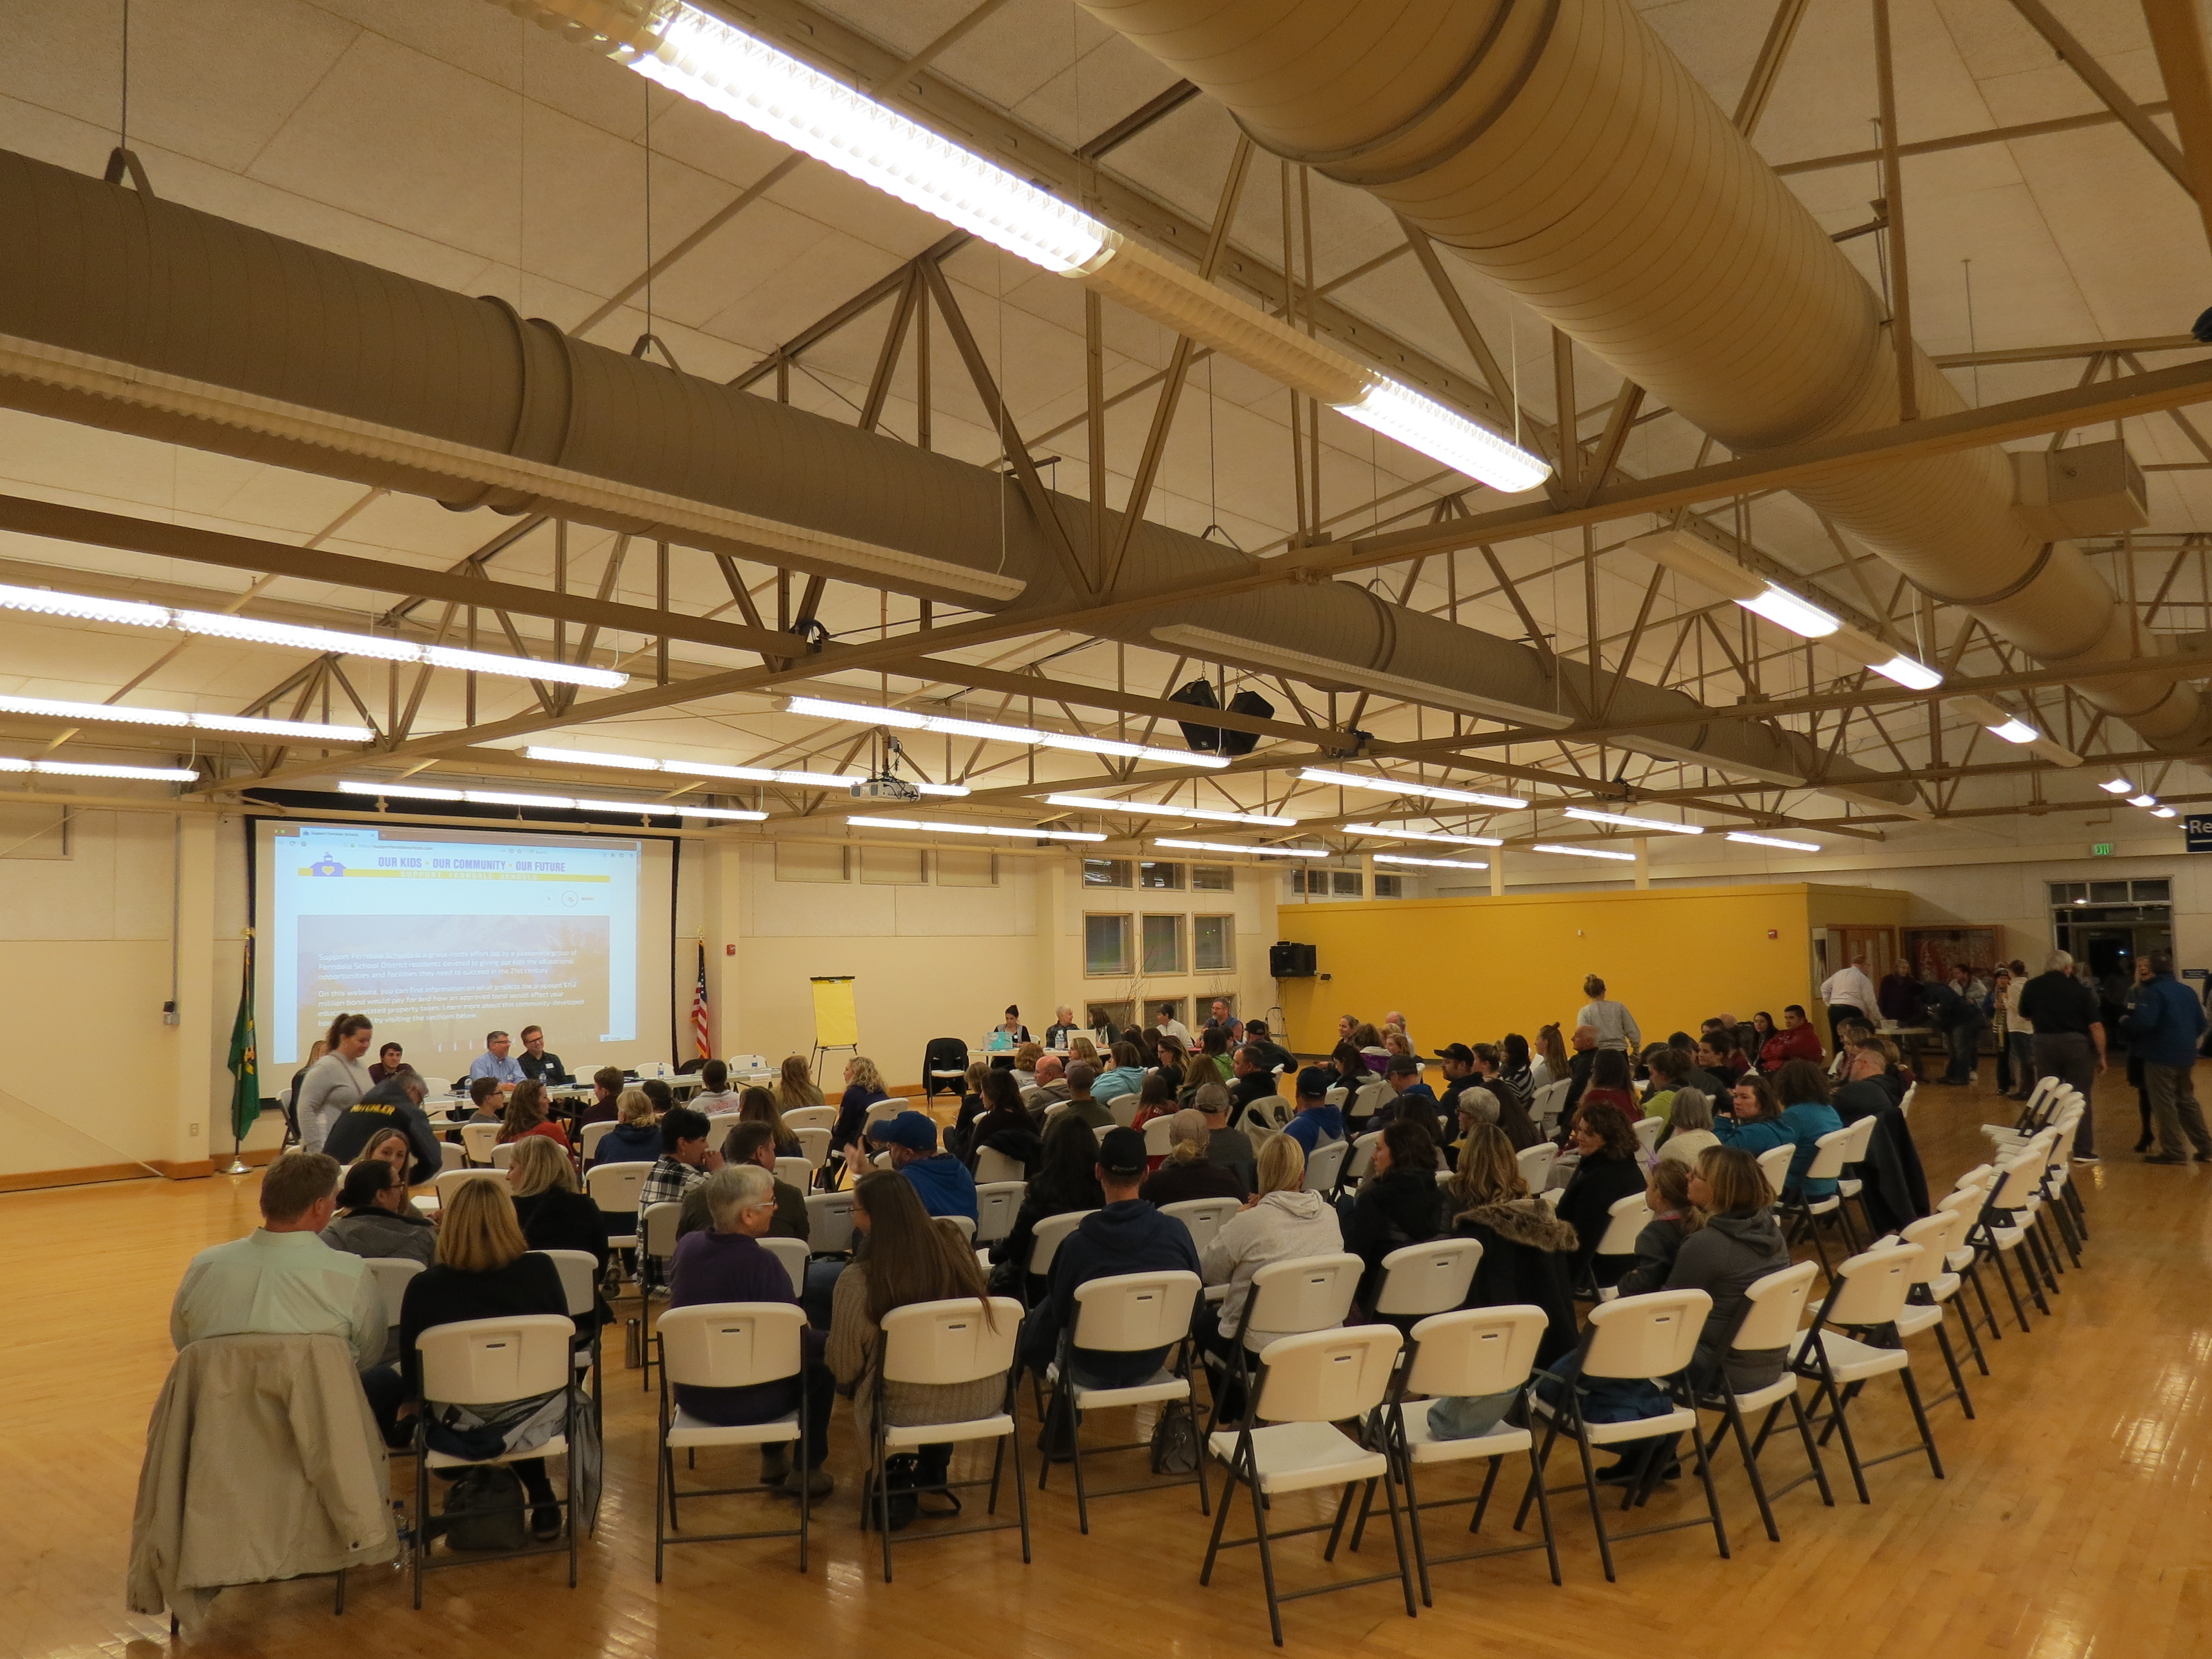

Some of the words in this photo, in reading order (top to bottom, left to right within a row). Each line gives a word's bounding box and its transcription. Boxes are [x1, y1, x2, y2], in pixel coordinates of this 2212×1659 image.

[378, 857, 397, 867] OUR
[400, 858, 422, 868] KIDS
[433, 858, 451, 869] OUR
[453, 859, 506, 870] COMMUNITY
[516, 861, 532, 871] OUR
[535, 862, 566, 872] FUTURE
[387, 1006, 419, 1015] property
